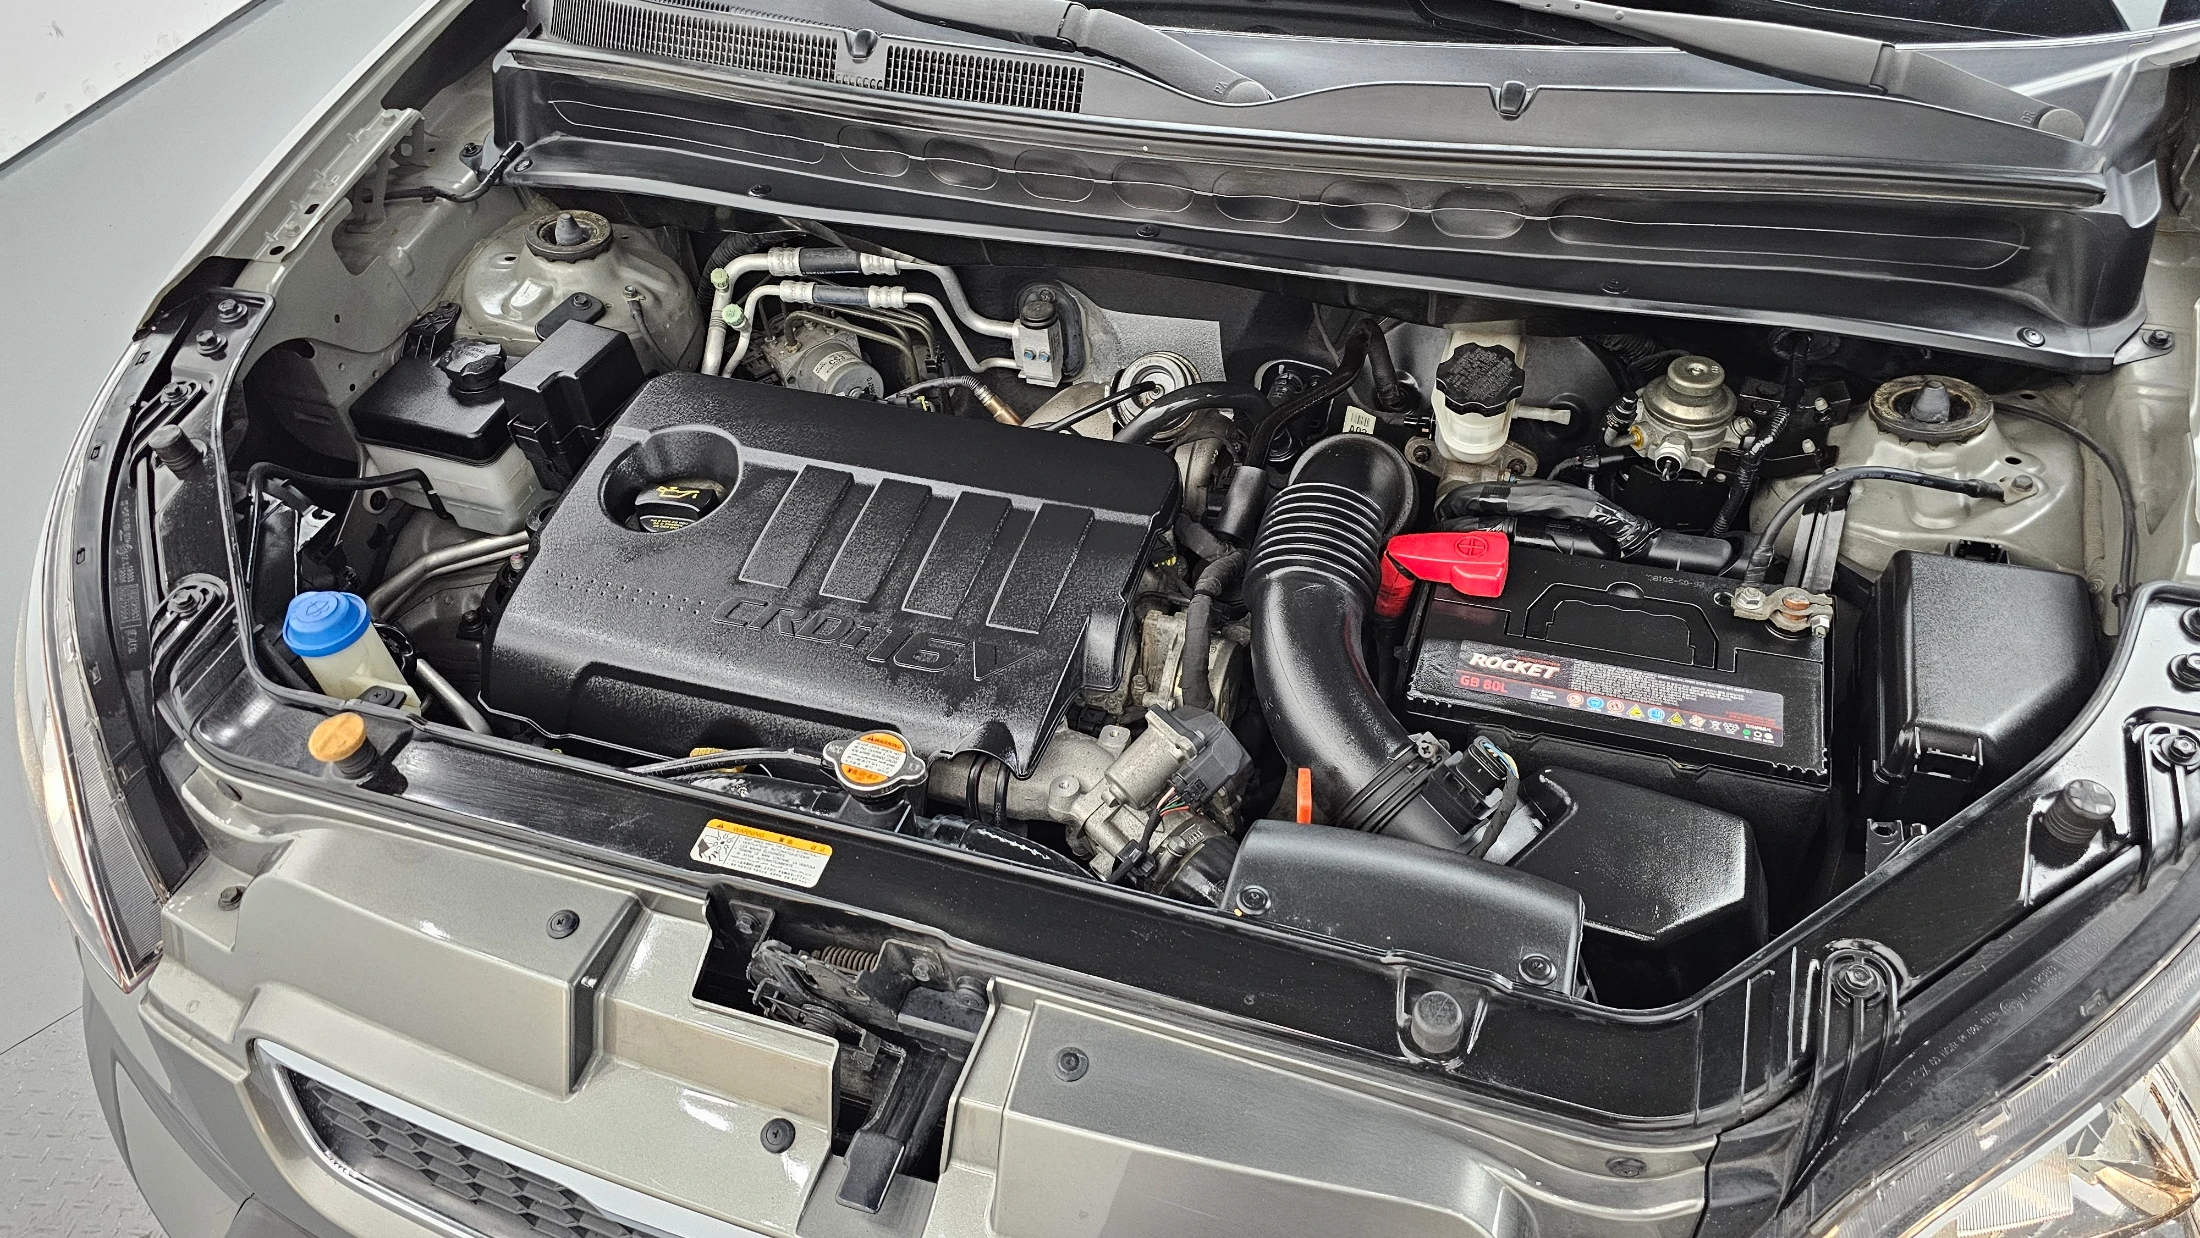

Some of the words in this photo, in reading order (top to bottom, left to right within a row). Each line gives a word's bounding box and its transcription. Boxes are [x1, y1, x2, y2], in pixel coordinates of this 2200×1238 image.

[712, 599, 878, 650] CRDi
[866, 622, 1040, 682] 16V
[1468, 653, 1560, 679] ROCKET
[1460, 675, 1480, 688] GB
[1482, 680, 1508, 694] 80L
[733, 826, 765, 838] WARNING
